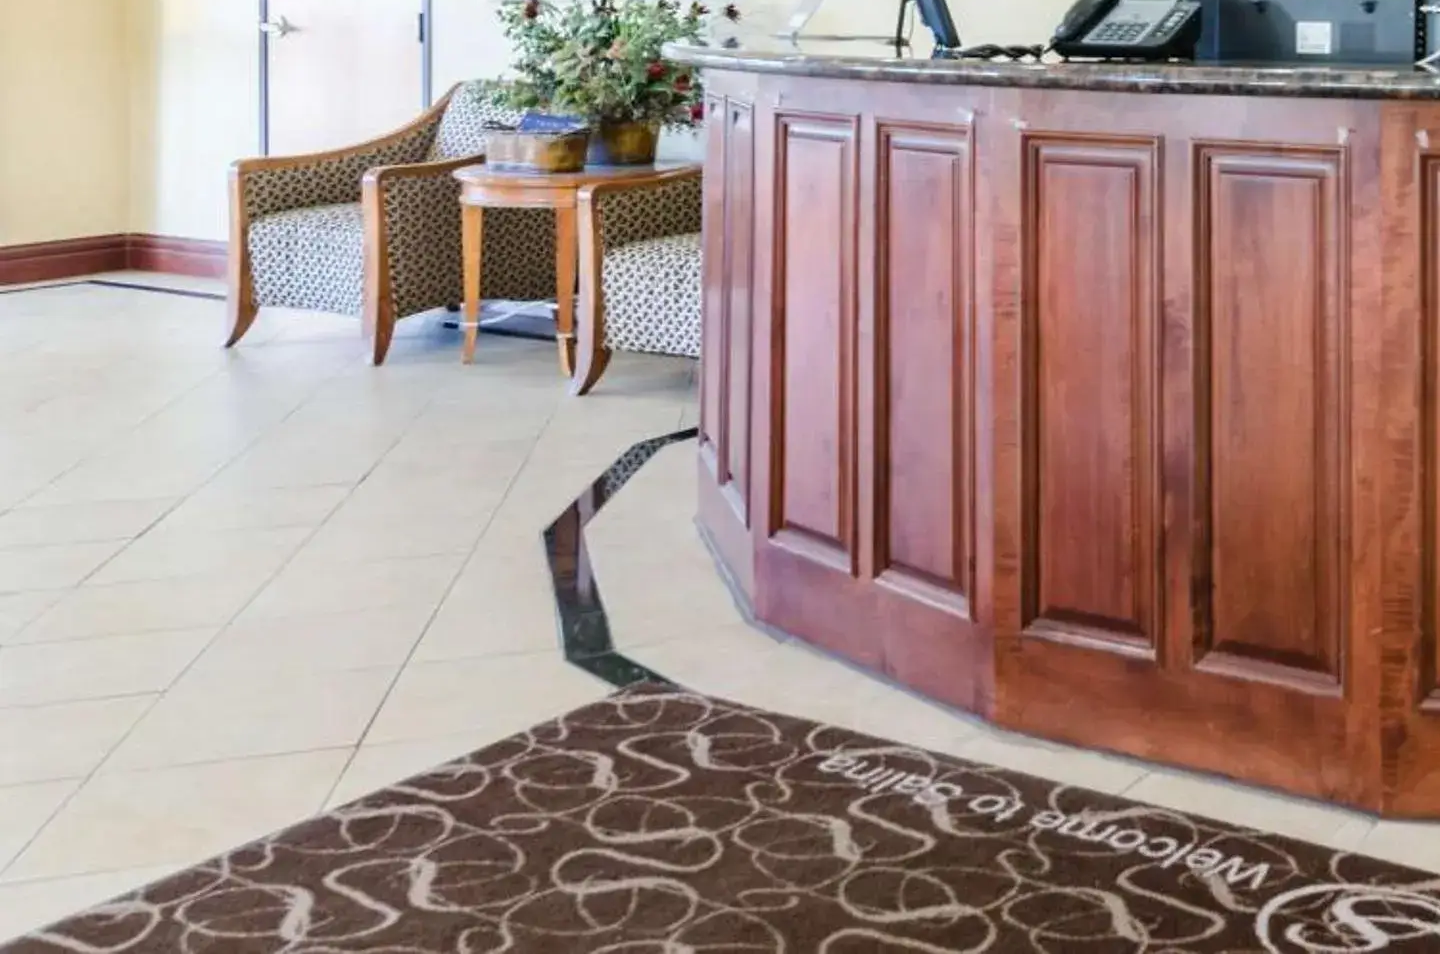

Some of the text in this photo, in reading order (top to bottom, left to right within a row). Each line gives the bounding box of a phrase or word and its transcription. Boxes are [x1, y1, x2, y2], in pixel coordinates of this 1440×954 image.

[816, 753, 1271, 891] Welcome to Salina
